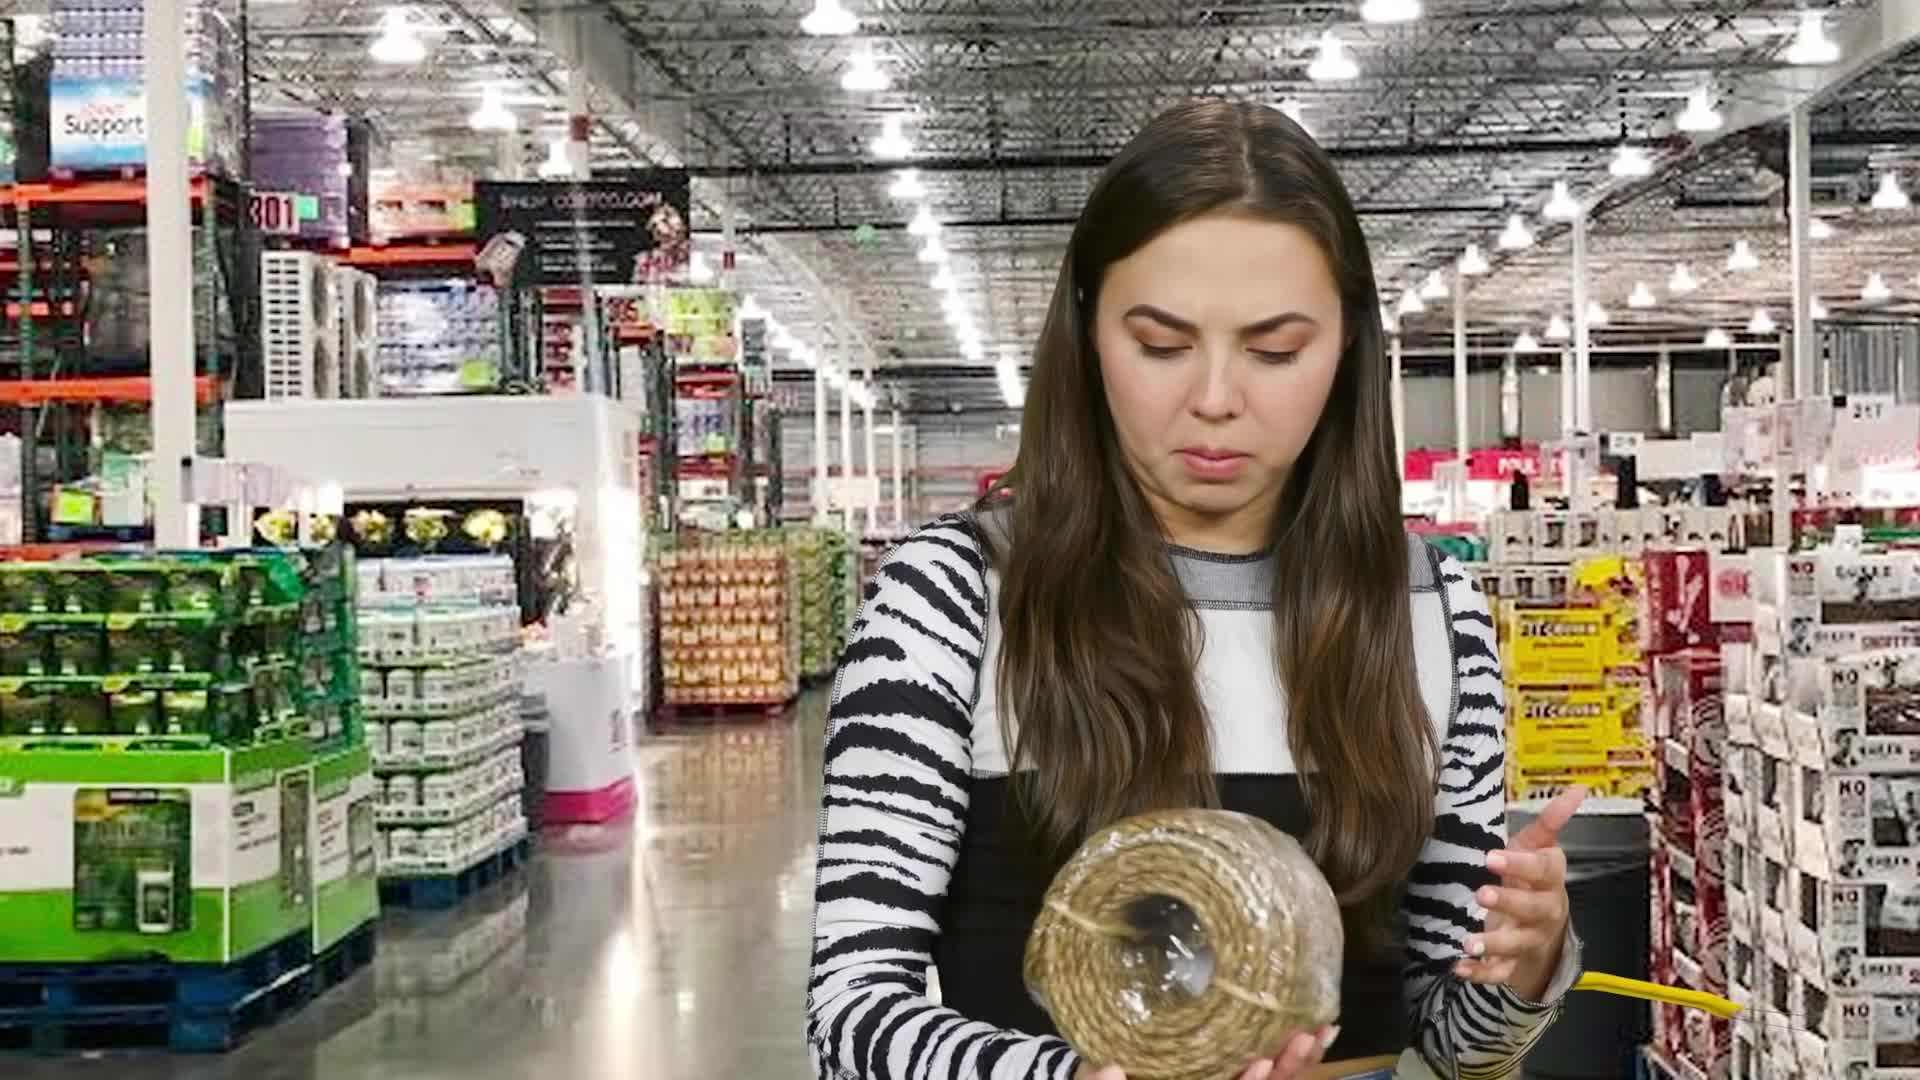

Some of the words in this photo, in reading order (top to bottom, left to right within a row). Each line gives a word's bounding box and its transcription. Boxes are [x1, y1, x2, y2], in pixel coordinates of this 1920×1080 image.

[64, 114, 144, 141] Support
[248, 196, 293, 230] 301
[1791, 561, 1814, 574] NO
[1832, 669, 1858, 684] NO
[1840, 780, 1866, 795] NO
[1832, 891, 1858, 902] NO
[1843, 1003, 1869, 1017] NO
